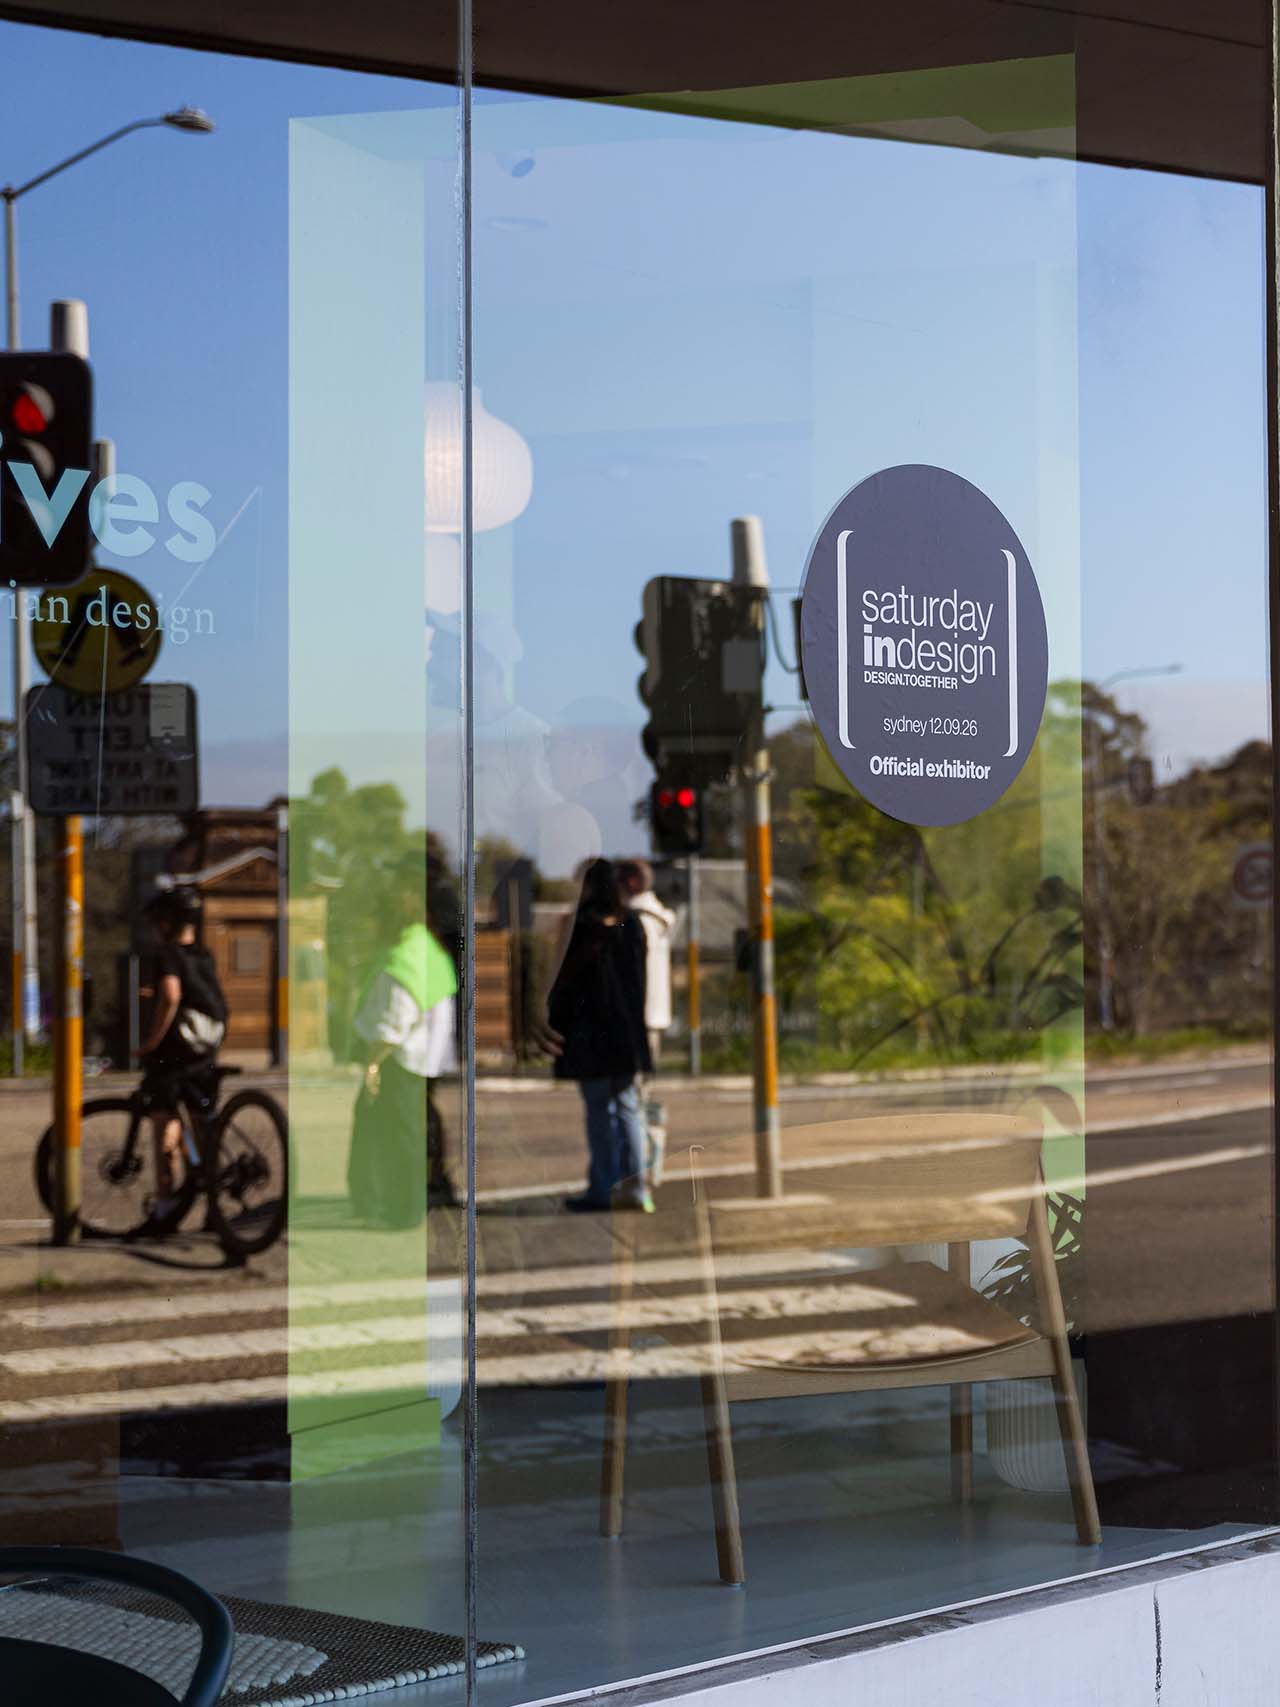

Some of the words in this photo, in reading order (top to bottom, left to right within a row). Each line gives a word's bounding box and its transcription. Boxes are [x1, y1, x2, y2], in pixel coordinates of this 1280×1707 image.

[0, 431, 217, 563] ves
[0, 578, 71, 625] ian
[86, 586, 216, 645] design
[861, 585, 994, 641] saturday
[863, 624, 996, 684] indesign
[864, 671, 958, 690] DESIGN.TOGETHER
[883, 715, 927, 737] sydney
[929, 717, 978, 737] 12.09.26
[869, 755, 924, 778] Official
[926, 757, 991, 779] exhibitor
